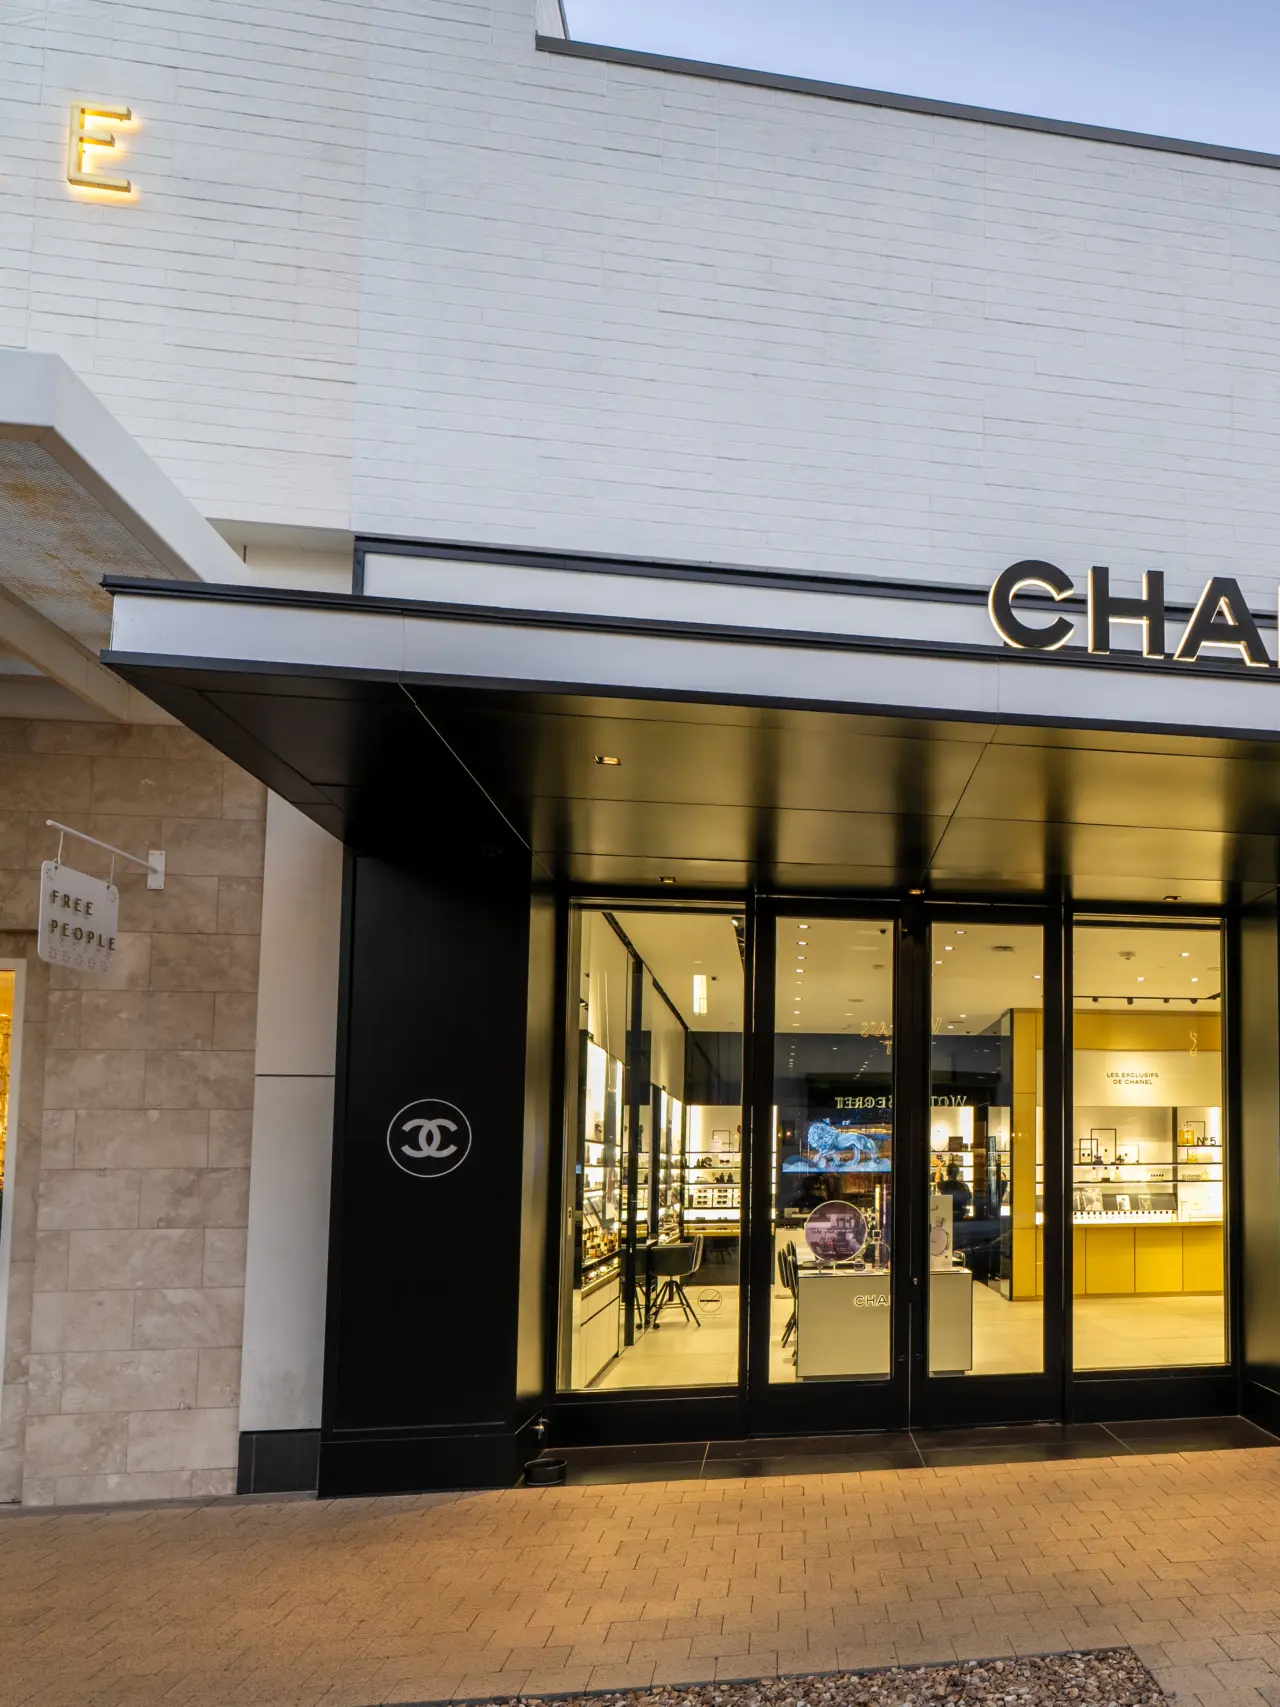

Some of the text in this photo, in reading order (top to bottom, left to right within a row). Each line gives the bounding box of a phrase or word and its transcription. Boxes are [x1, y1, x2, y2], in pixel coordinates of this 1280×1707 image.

[67, 101, 132, 193] E
[51, 889, 94, 917] FREE
[50, 919, 117, 951] PEOPLE
